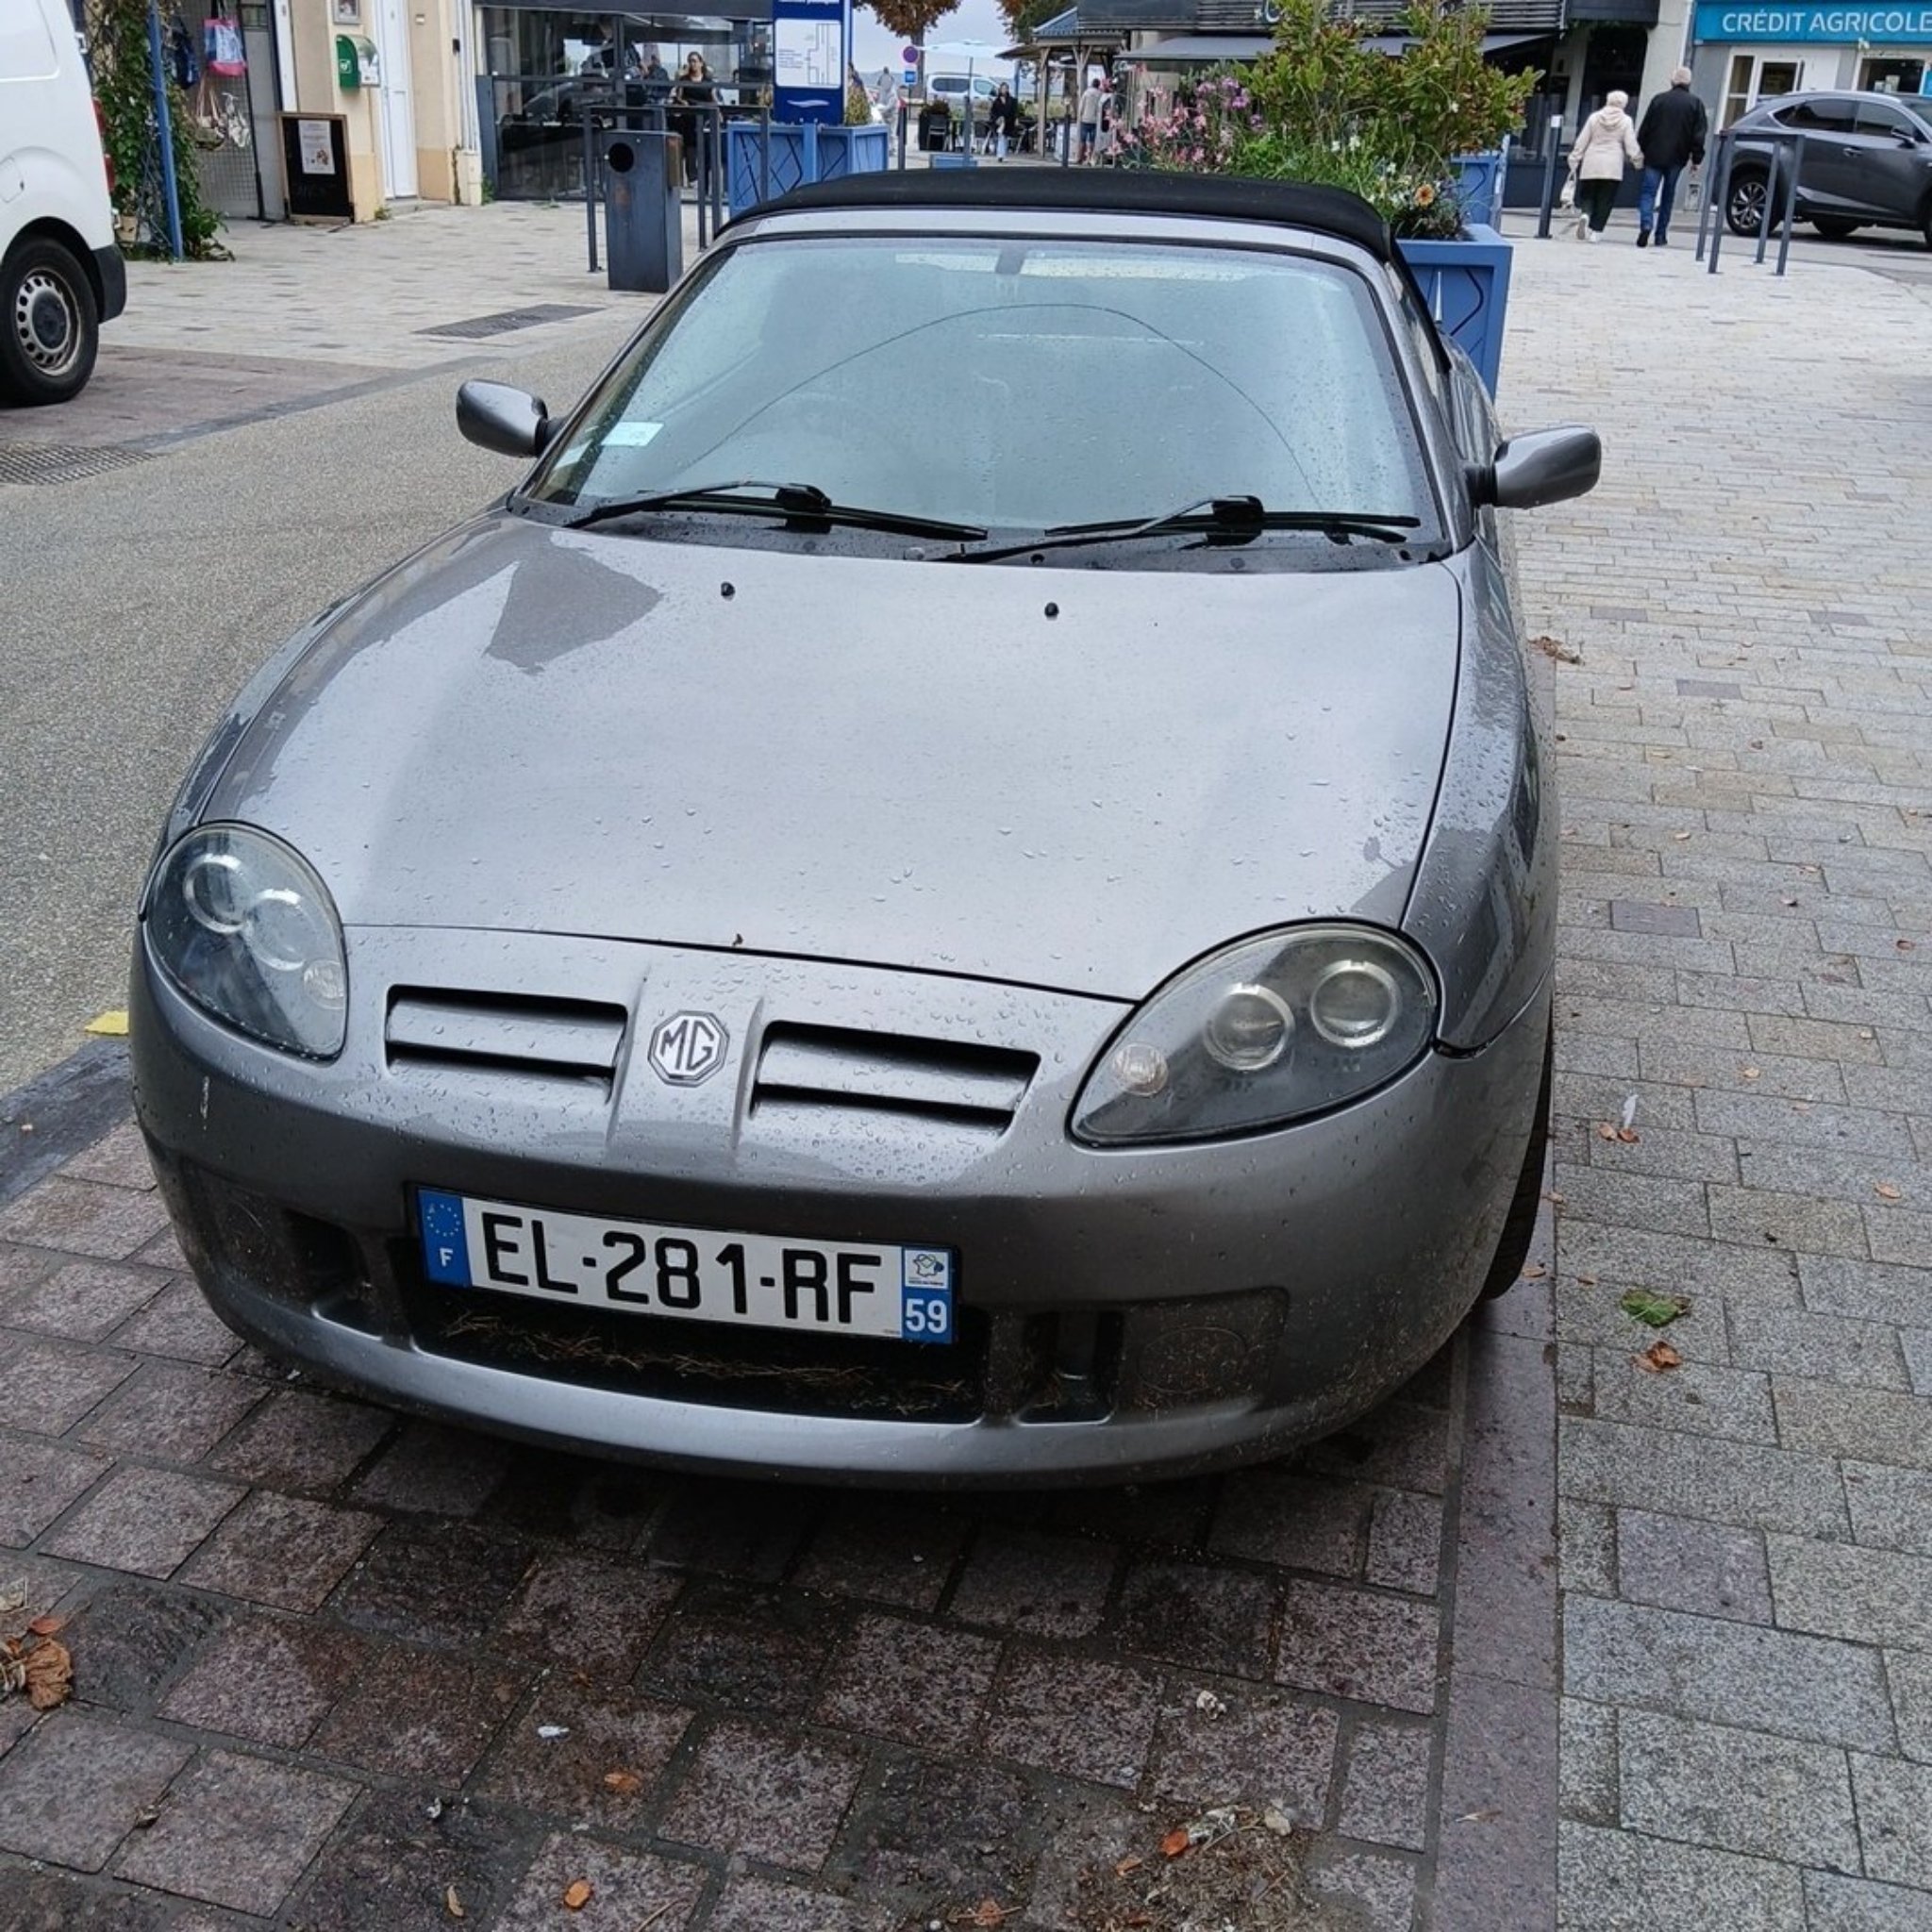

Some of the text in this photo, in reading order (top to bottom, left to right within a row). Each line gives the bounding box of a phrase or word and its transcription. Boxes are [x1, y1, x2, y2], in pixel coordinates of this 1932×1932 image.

[1723, 8, 1932, 33] CRÉDIT AGRICOLE
[659, 1019, 714, 1071] MG
[440, 1247, 453, 1266] F
[481, 1211, 882, 1324] EL-281-RF
[906, 1298, 947, 1334] 59
